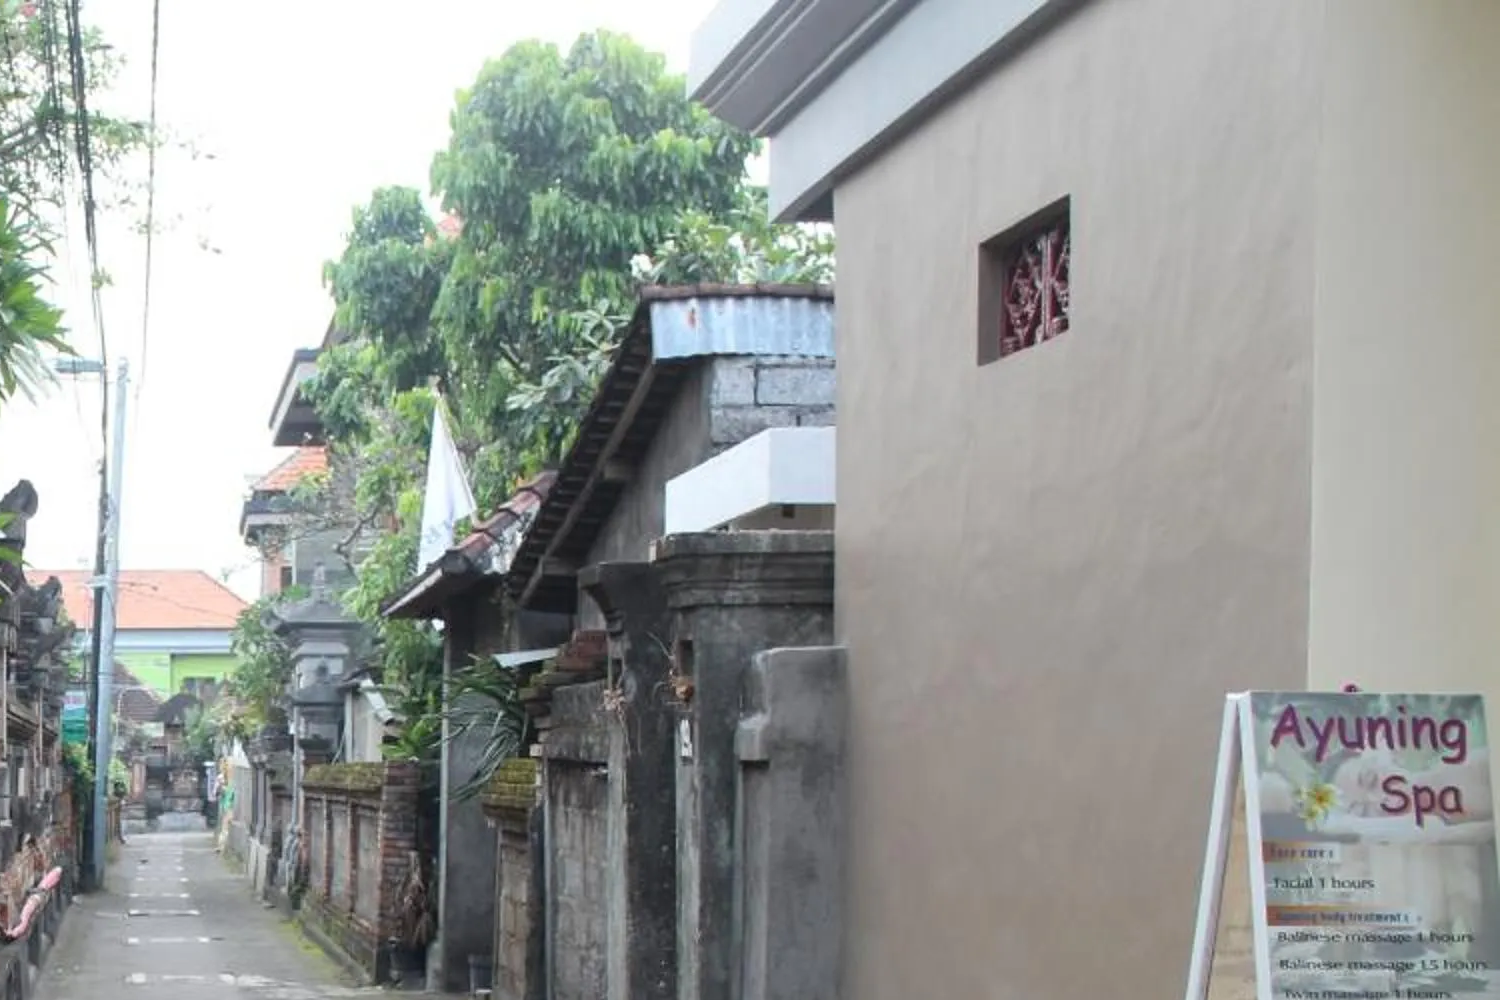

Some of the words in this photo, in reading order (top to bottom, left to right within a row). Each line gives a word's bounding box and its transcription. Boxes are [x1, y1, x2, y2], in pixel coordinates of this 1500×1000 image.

[1270, 703, 1468, 764] Ayuning
[1380, 775, 1464, 828] Spa
[1331, 878, 1375, 889] hours
[1277, 932, 1341, 943] Balinese
[1345, 933, 1412, 944] massage
[1430, 932, 1474, 942] hours
[1279, 960, 1343, 970] Balinese
[1348, 961, 1414, 972] massage
[1443, 960, 1488, 970] hours
[1407, 989, 1452, 999] hours
